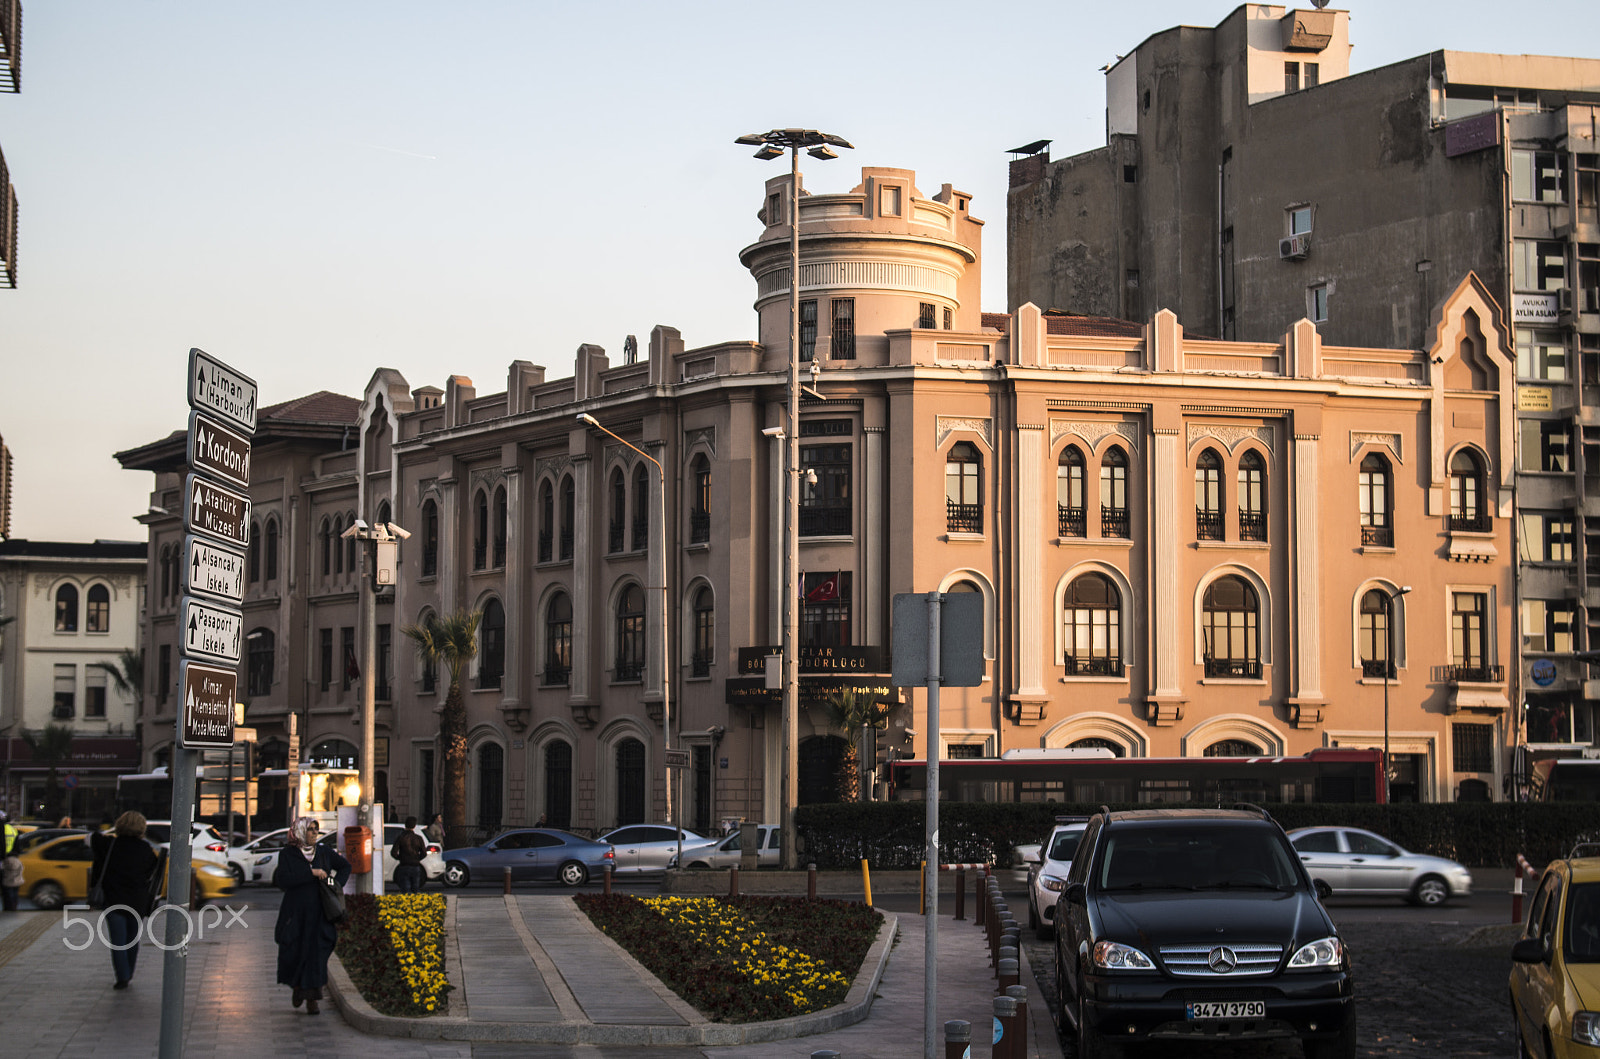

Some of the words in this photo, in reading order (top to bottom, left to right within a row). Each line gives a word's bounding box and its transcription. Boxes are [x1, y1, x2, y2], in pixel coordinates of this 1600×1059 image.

[1515, 309, 1534, 317] AYLİN
[1535, 309, 1557, 318] ASLAN
[210, 366, 243, 400] Liman
[206, 383, 246, 421] (Harbour)
[207, 431, 241, 474] Kordon
[204, 488, 237, 517] Atatürk
[205, 511, 236, 537] Müzesi
[202, 547, 236, 573] Alsancak
[206, 568, 229, 594] İskele
[198, 608, 232, 634] Pasaport
[202, 628, 225, 655] İskele
[772, 647, 833, 657] VAFLAR
[202, 677, 223, 695] Mimar
[852, 686, 890, 696] Başknlığı
[195, 696, 227, 716] Kemalettin
[192, 718, 207, 736] Moda
[206, 719, 228, 737] Merkezi
[1194, 1003, 1210, 1017] 34
[1211, 1002, 1229, 1017] ZV
[1230, 1002, 1264, 1016] 3790
